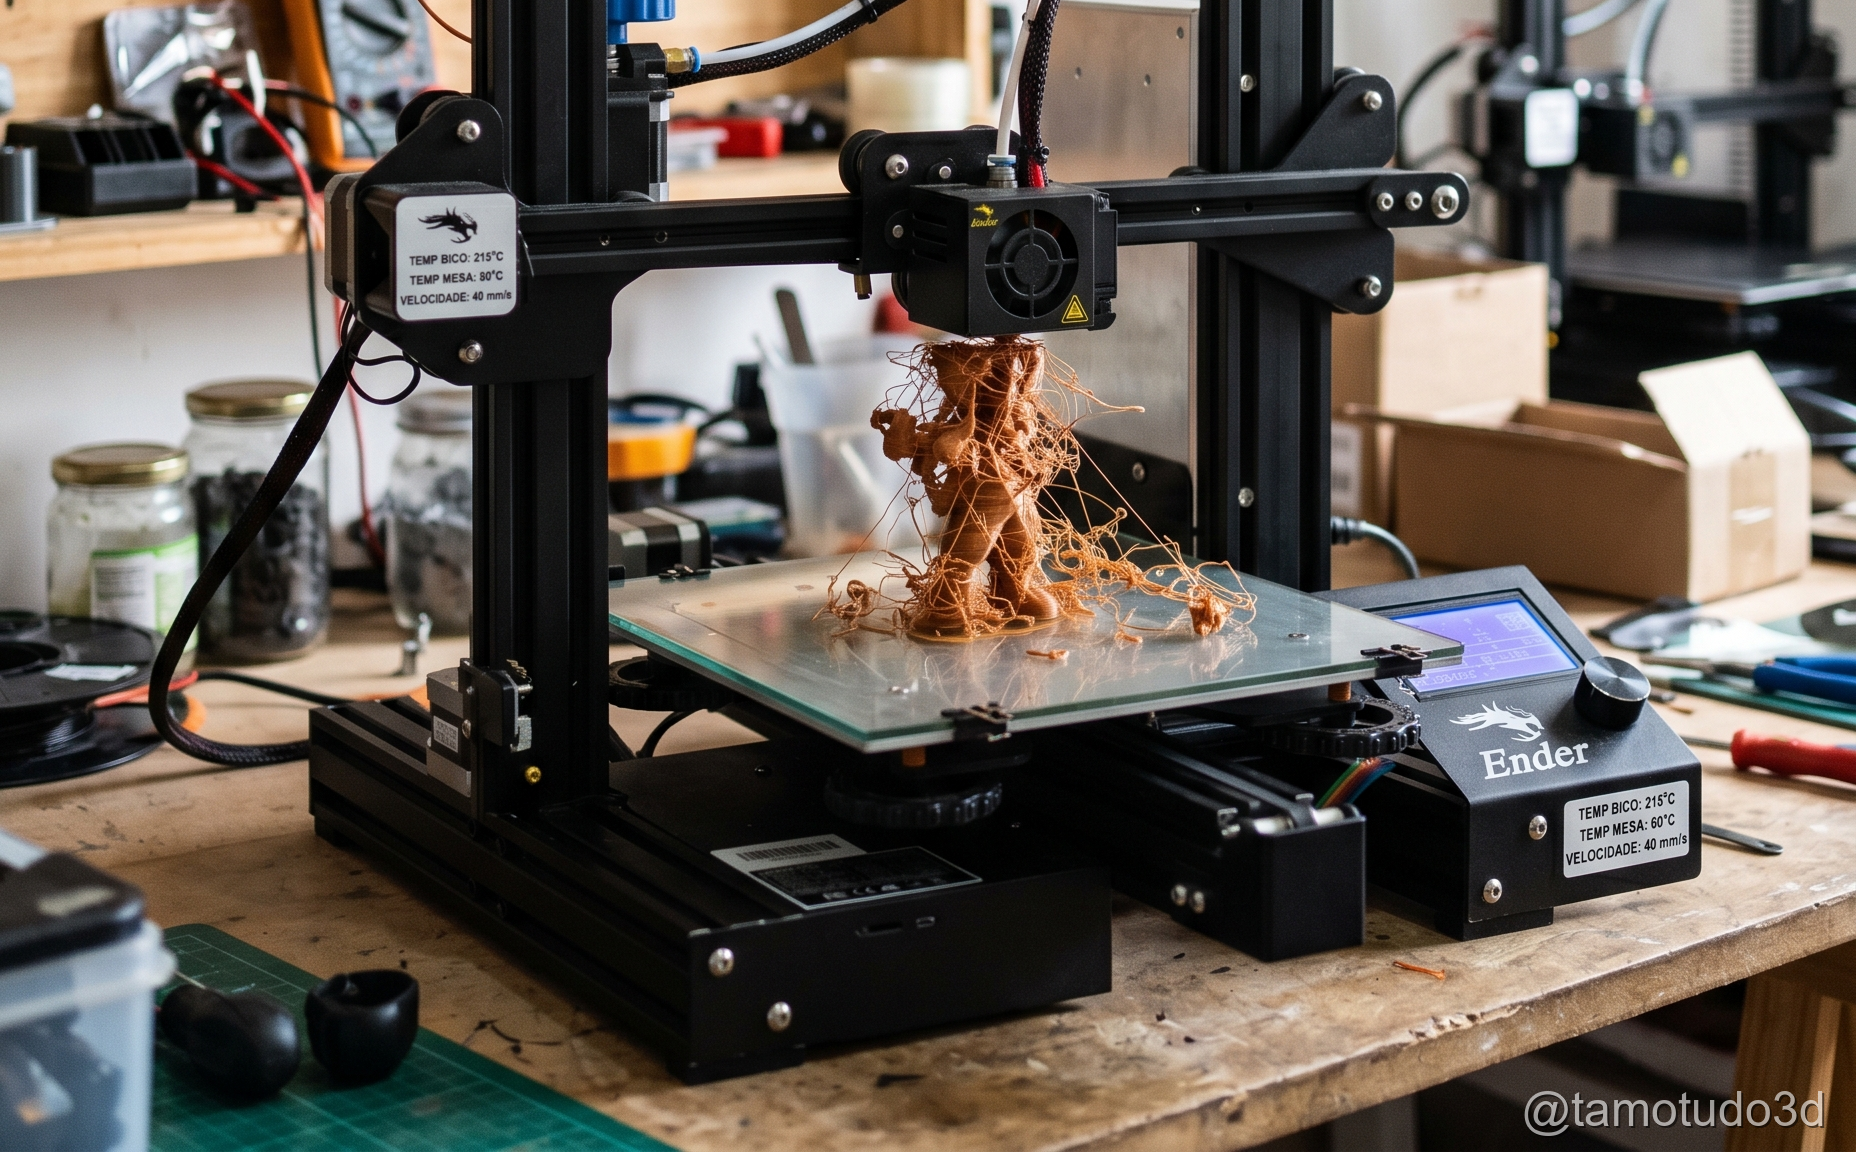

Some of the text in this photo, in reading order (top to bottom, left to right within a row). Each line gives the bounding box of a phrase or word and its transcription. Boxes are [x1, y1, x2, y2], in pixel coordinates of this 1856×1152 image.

[409, 254, 438, 266] TEMP
[441, 252, 471, 264] BICO:
[410, 274, 439, 285] TEMP
[442, 272, 477, 284] MESA:
[400, 289, 512, 306] VELOCIDADE: 40 mm/s
[1478, 740, 1590, 780] Ender
[1578, 803, 1609, 821] TEMP
[1611, 798, 1642, 815] BICO:
[1579, 813, 1676, 842] TEMP MESA: 60°C
[1565, 832, 1688, 866] VELOCIDADE: 40 mm/s
